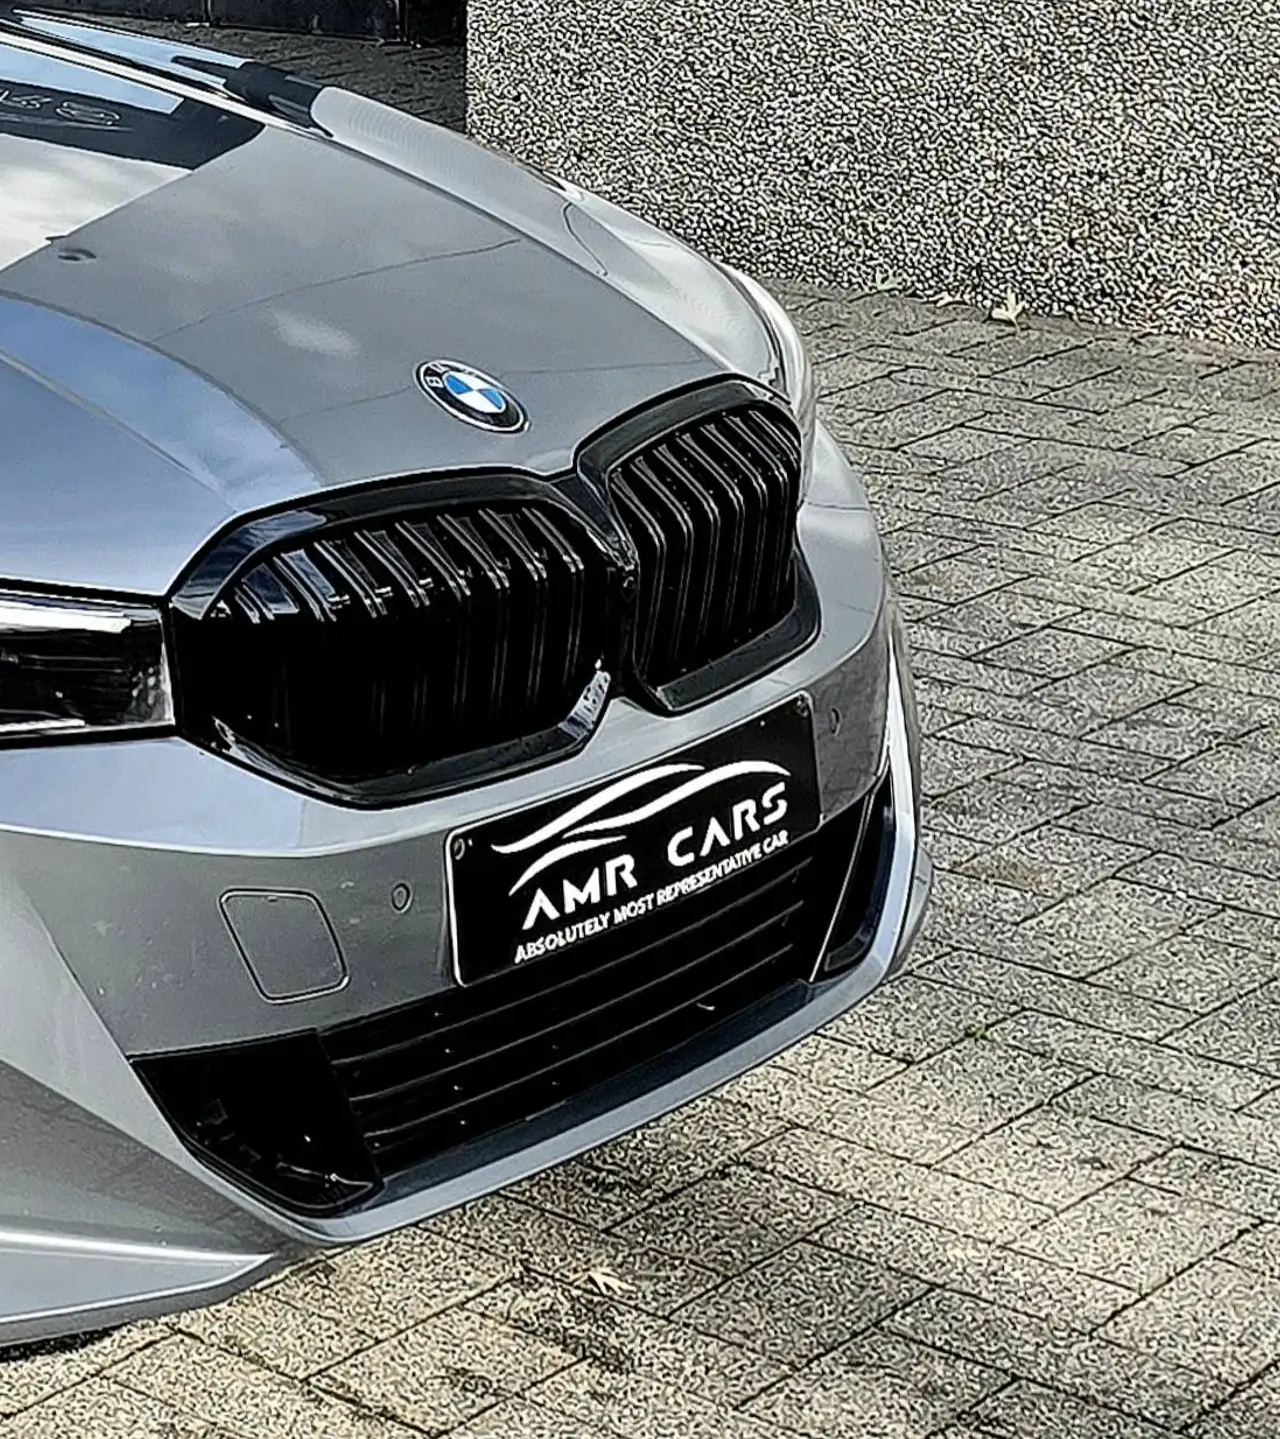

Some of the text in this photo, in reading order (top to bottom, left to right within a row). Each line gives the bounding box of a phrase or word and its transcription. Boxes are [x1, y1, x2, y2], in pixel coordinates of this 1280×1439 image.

[514, 829, 789, 965] ABSOLUTELY MOST REPRESENTATIVE CAR
[522, 781, 788, 931] AMR CARS
